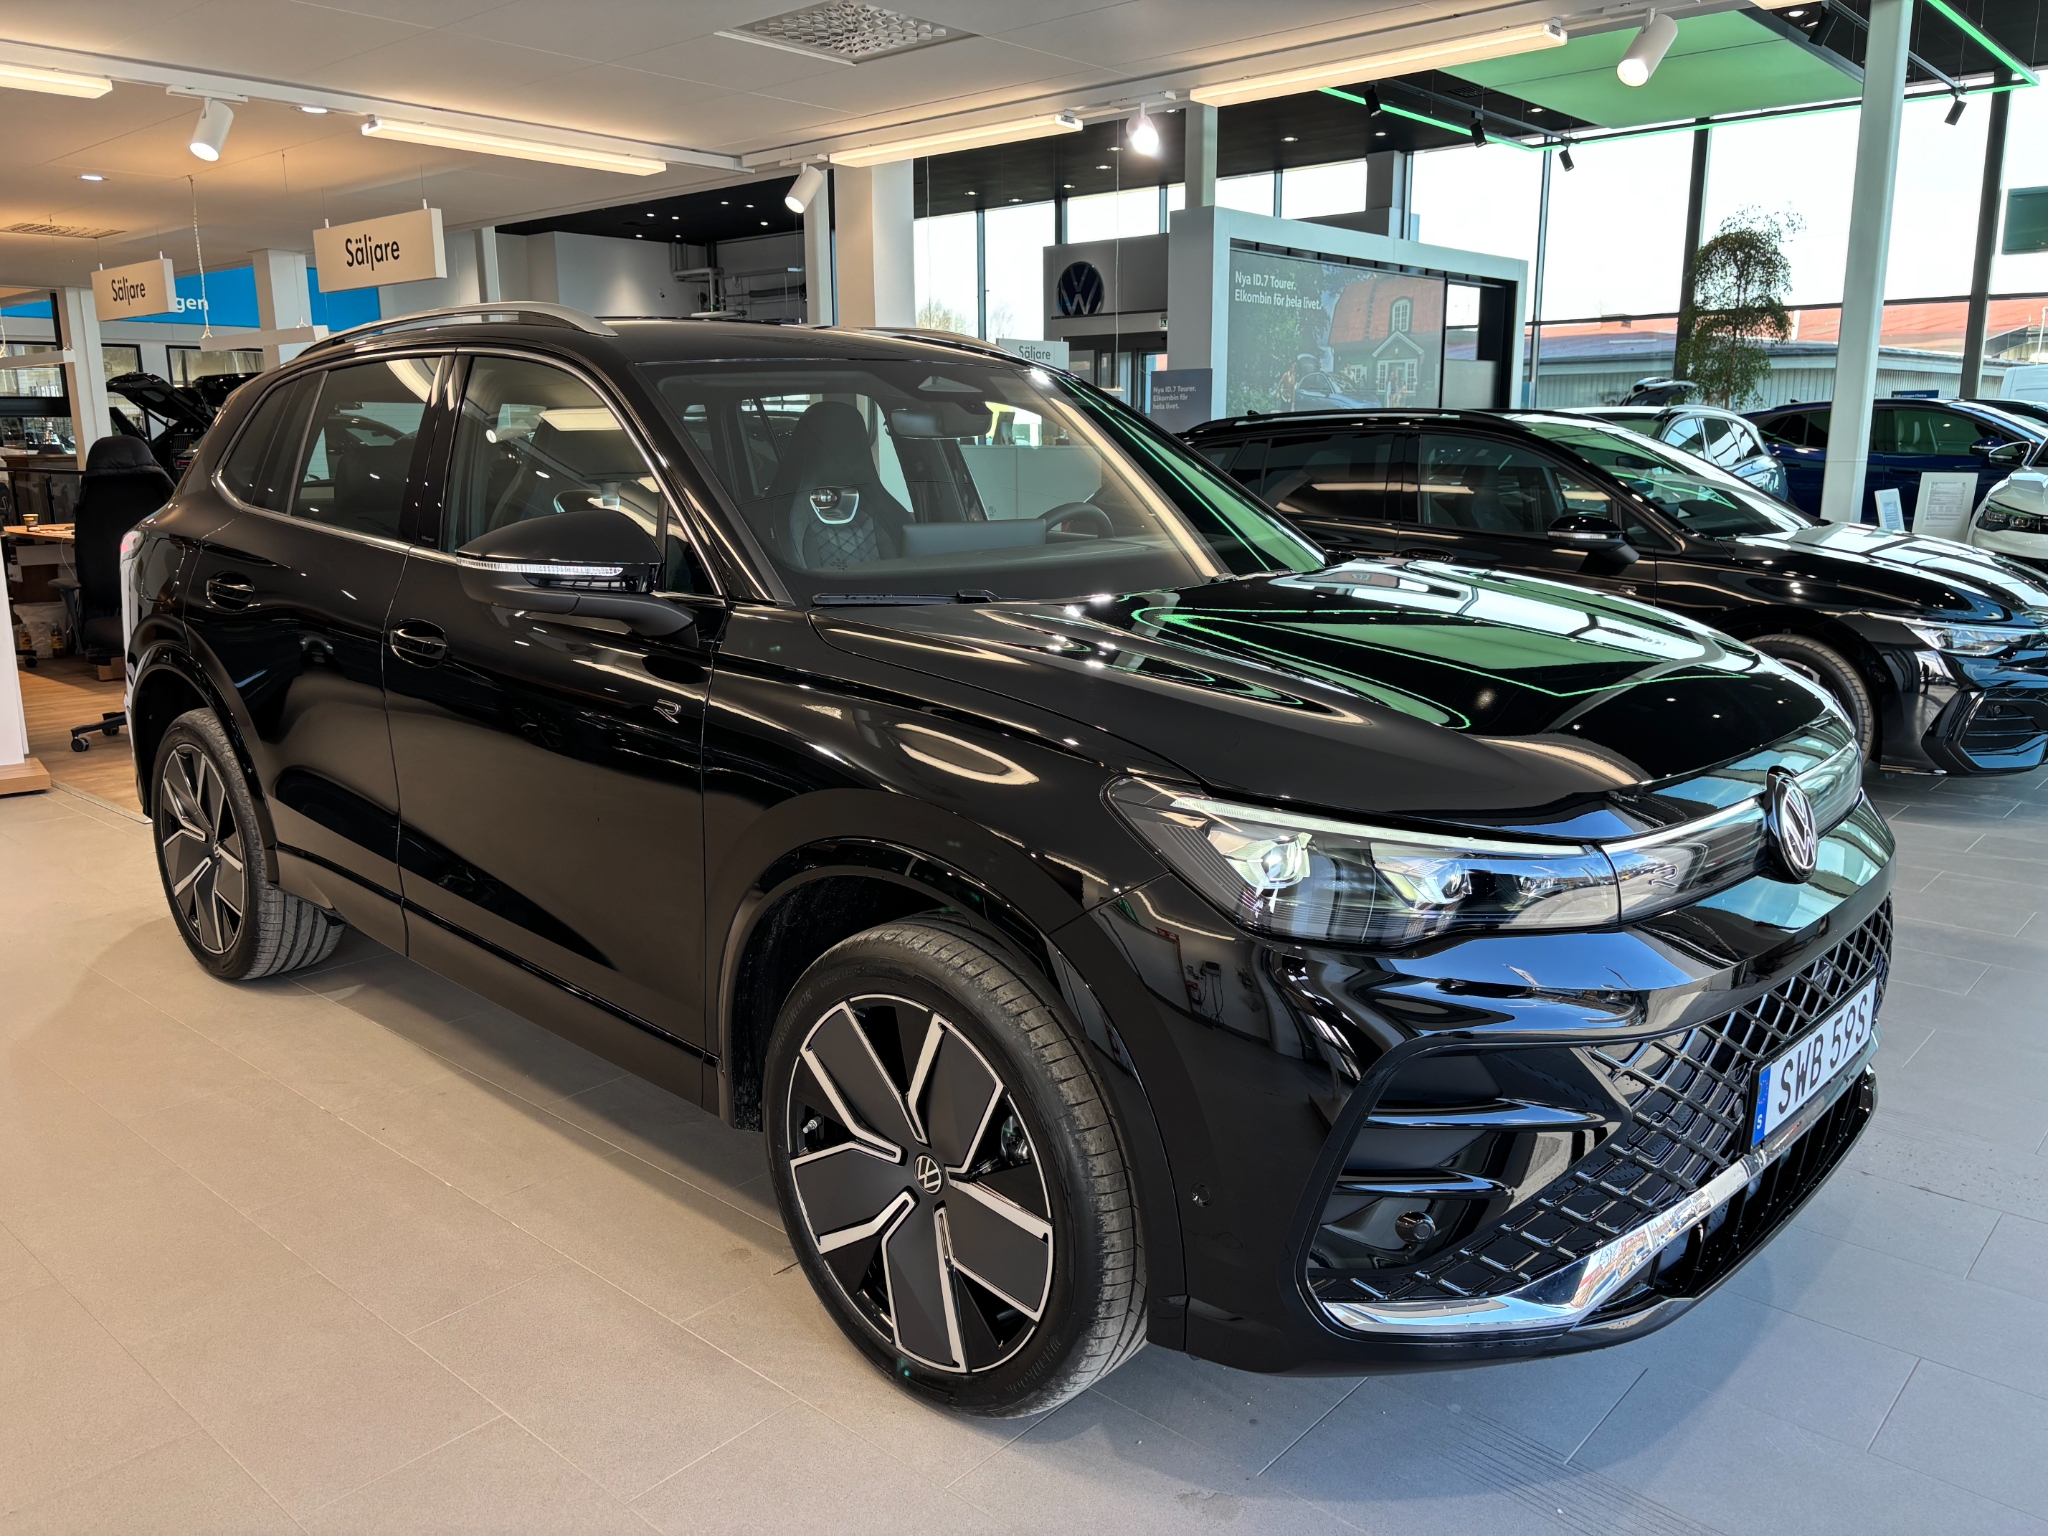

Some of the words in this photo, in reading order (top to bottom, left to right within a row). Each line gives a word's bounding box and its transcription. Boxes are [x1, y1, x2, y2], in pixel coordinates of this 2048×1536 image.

[345, 234, 400, 271] Säljare
[111, 276, 146, 305] Säljare
[1235, 271, 1251, 287] Nya
[1253, 273, 1269, 287] ID.7
[1270, 276, 1297, 290] Tourer.
[1235, 289, 1272, 304] Elkombin
[1273, 293, 1285, 306] för
[1286, 295, 1301, 307] hela
[1303, 297, 1322, 309] livet.
[1018, 345, 1051, 361] Säljare
[1778, 1033, 1824, 1115] SWB
[1829, 993, 1868, 1069] 59S
[1756, 1114, 1763, 1129] S
